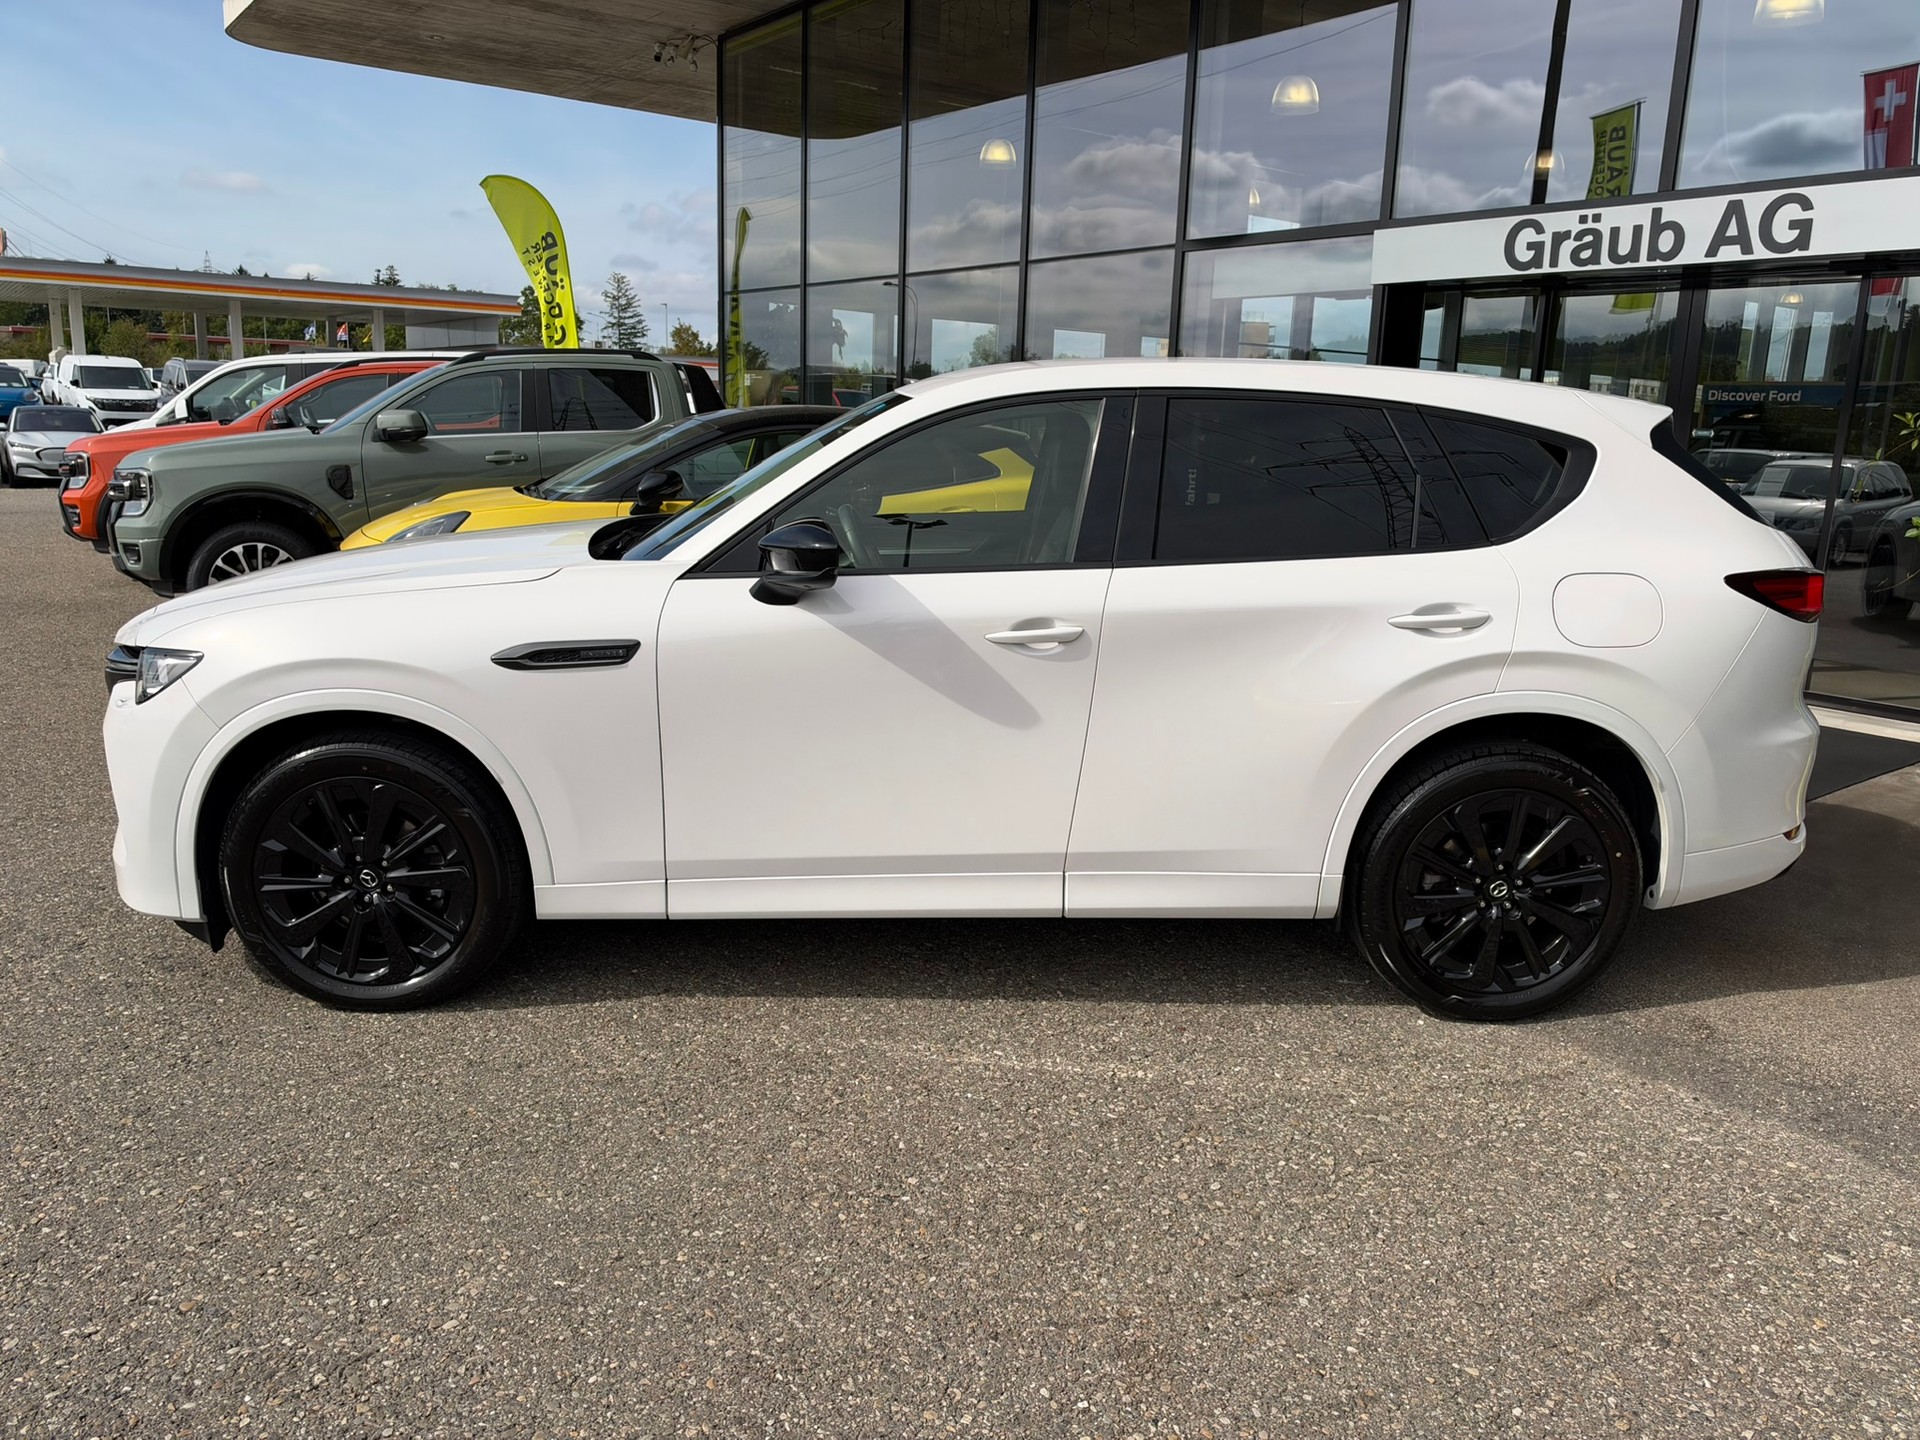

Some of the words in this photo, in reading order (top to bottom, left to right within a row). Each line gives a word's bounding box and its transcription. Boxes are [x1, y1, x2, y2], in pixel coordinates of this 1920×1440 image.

[1504, 207, 1685, 272] Gräub
[1704, 192, 1814, 258] AG
[1708, 390, 1767, 401] Discover
[1769, 390, 1802, 402] Ford
